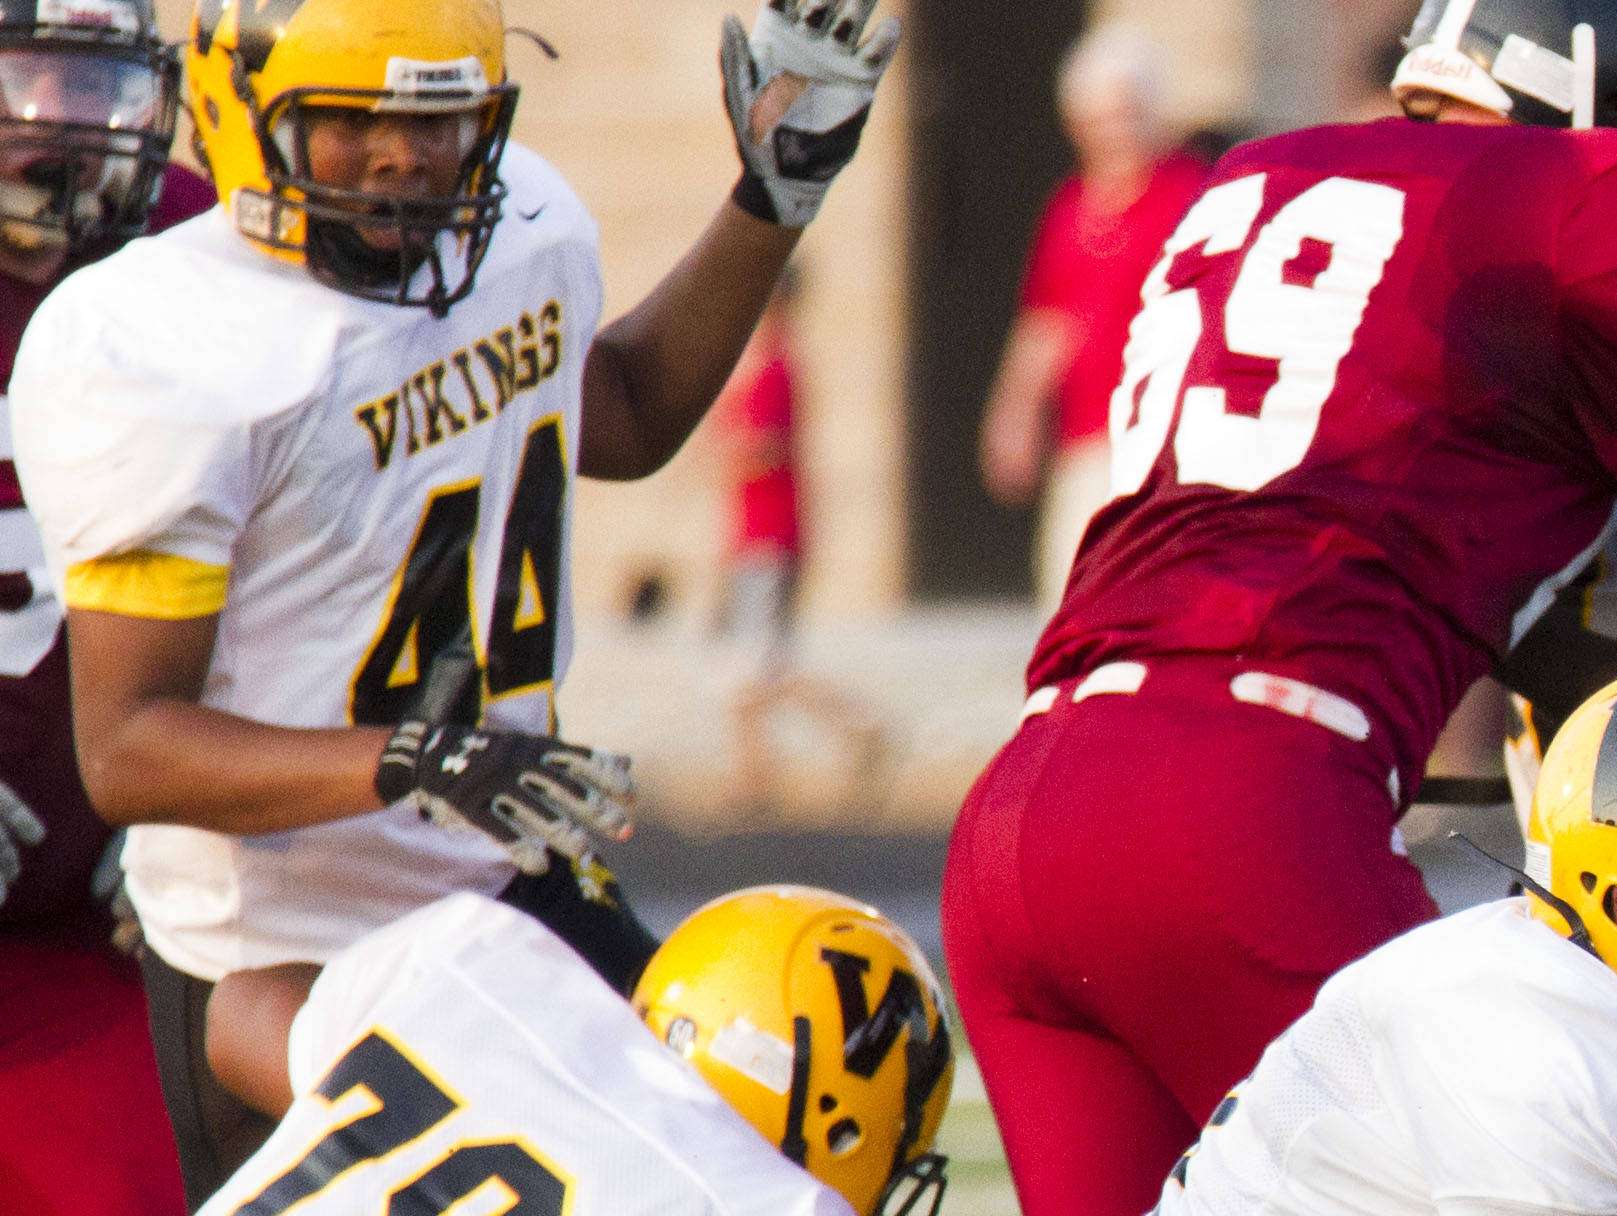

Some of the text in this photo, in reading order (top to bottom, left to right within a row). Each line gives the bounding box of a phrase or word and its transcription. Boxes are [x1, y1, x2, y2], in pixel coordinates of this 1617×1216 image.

[354, 299, 563, 471] VIKINGS
[1108, 172, 1407, 500] 69
[346, 411, 567, 735] 44
